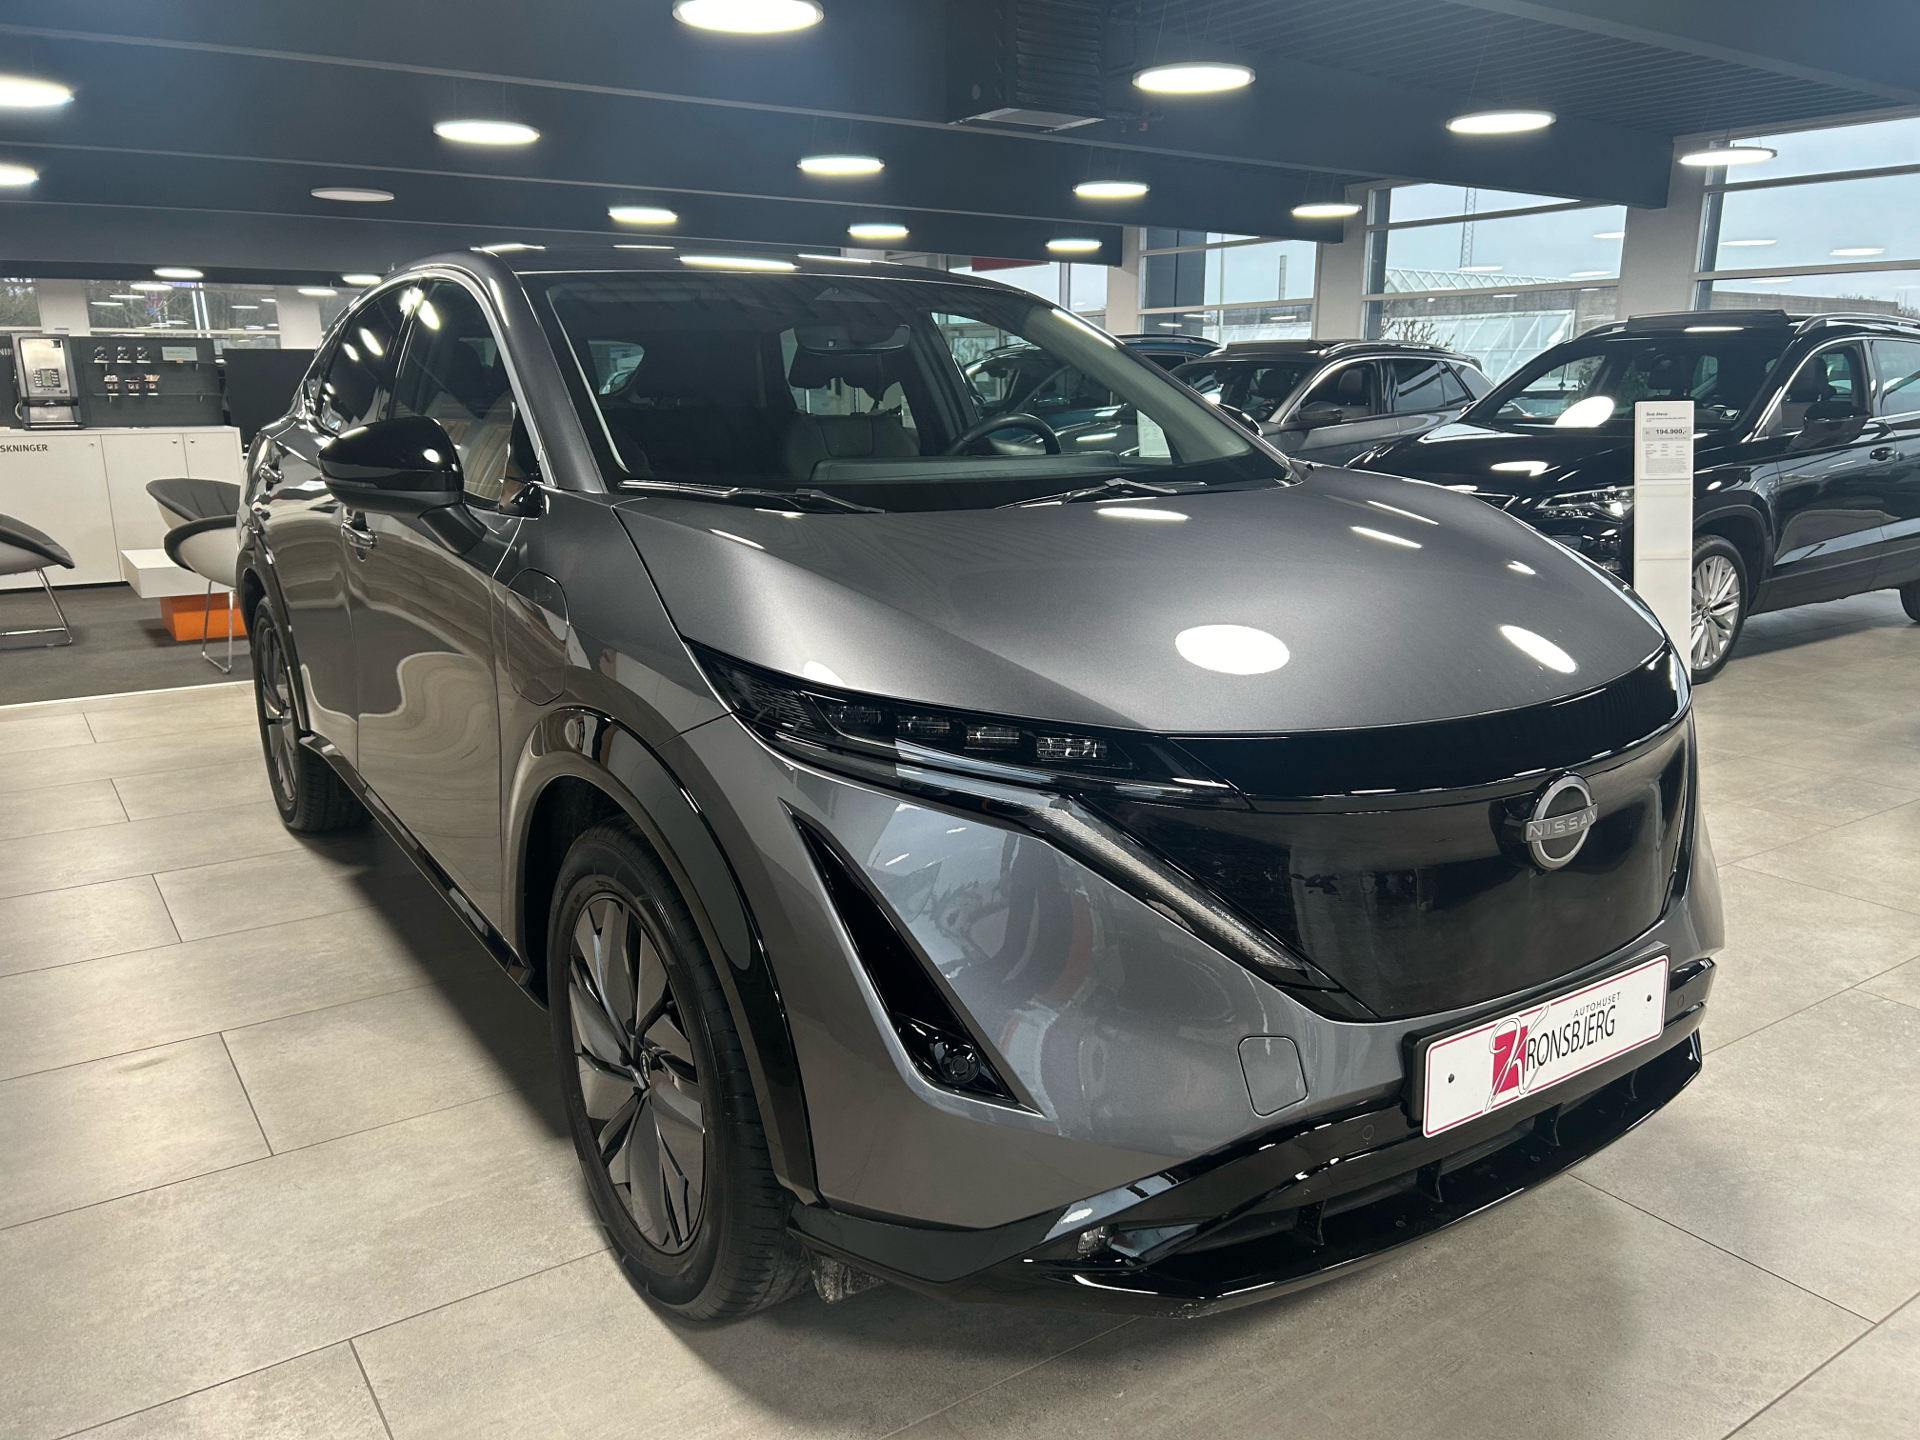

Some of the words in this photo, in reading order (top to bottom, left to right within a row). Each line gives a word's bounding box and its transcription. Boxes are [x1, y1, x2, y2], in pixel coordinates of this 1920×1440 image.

[0, 444, 48, 453] SKNINGER
[1529, 806, 1597, 838] NISSAN
[1573, 992, 1621, 1019] AUTOHUSET
[1485, 1005, 1616, 1112] KRONSBJERG
